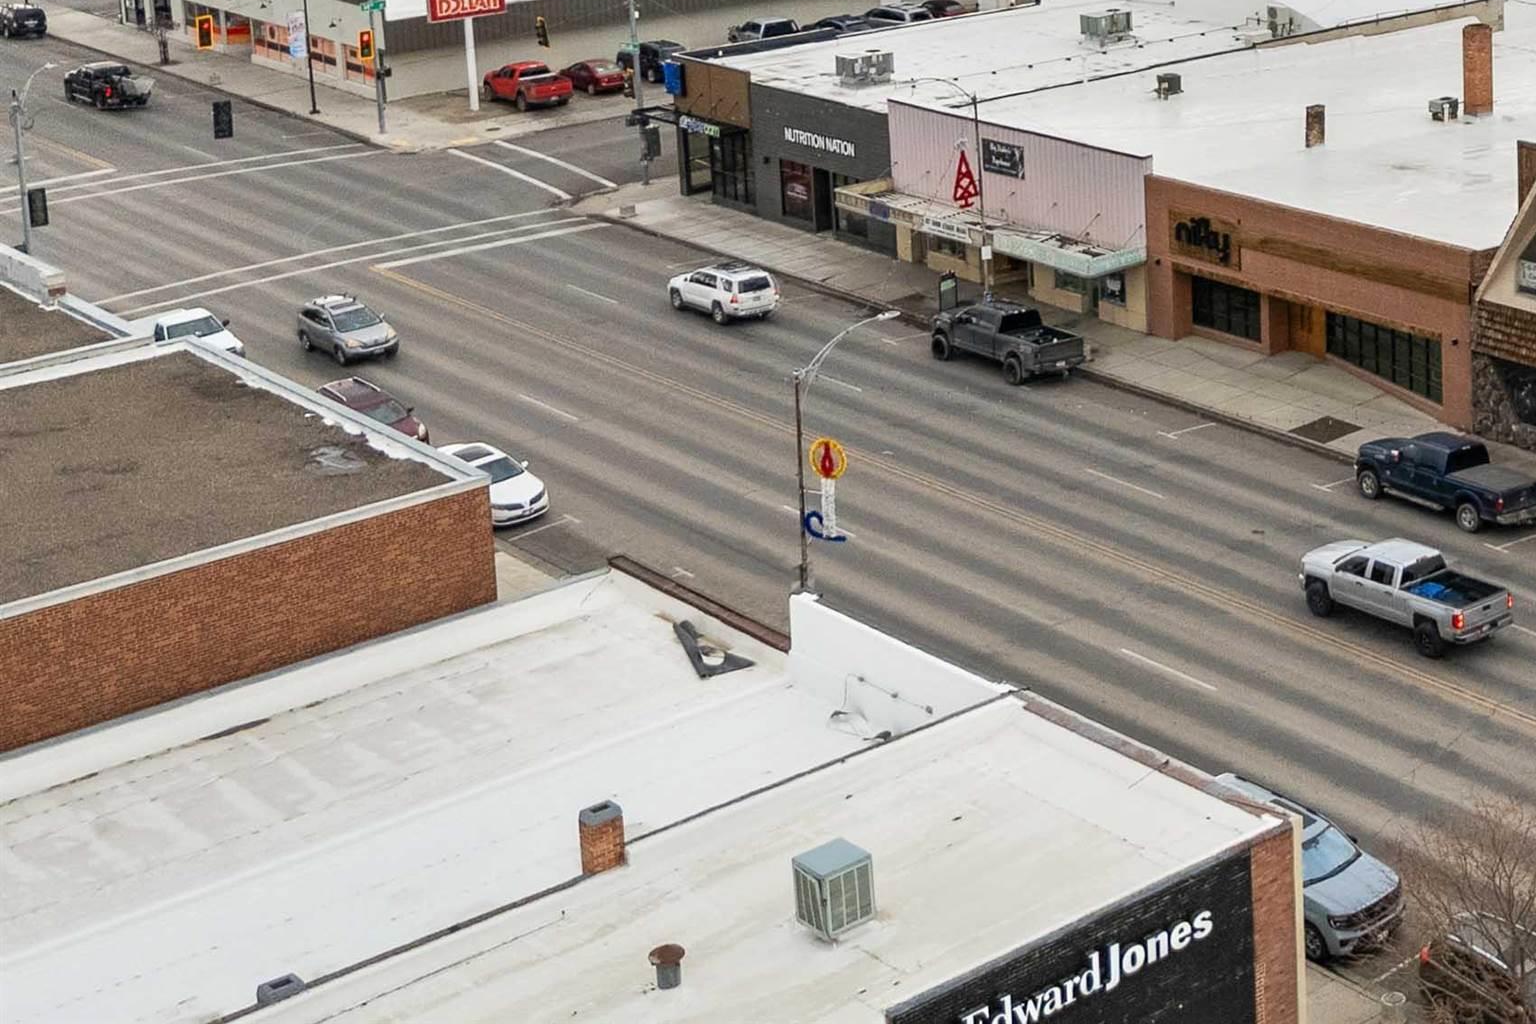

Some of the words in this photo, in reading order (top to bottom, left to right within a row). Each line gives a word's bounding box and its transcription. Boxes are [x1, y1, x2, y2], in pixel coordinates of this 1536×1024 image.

[784, 126, 825, 150] NUTRITION
[825, 136, 856, 157] NATION
[1175, 216, 1230, 265] nifty
[1105, 910, 1214, 991] Jones
